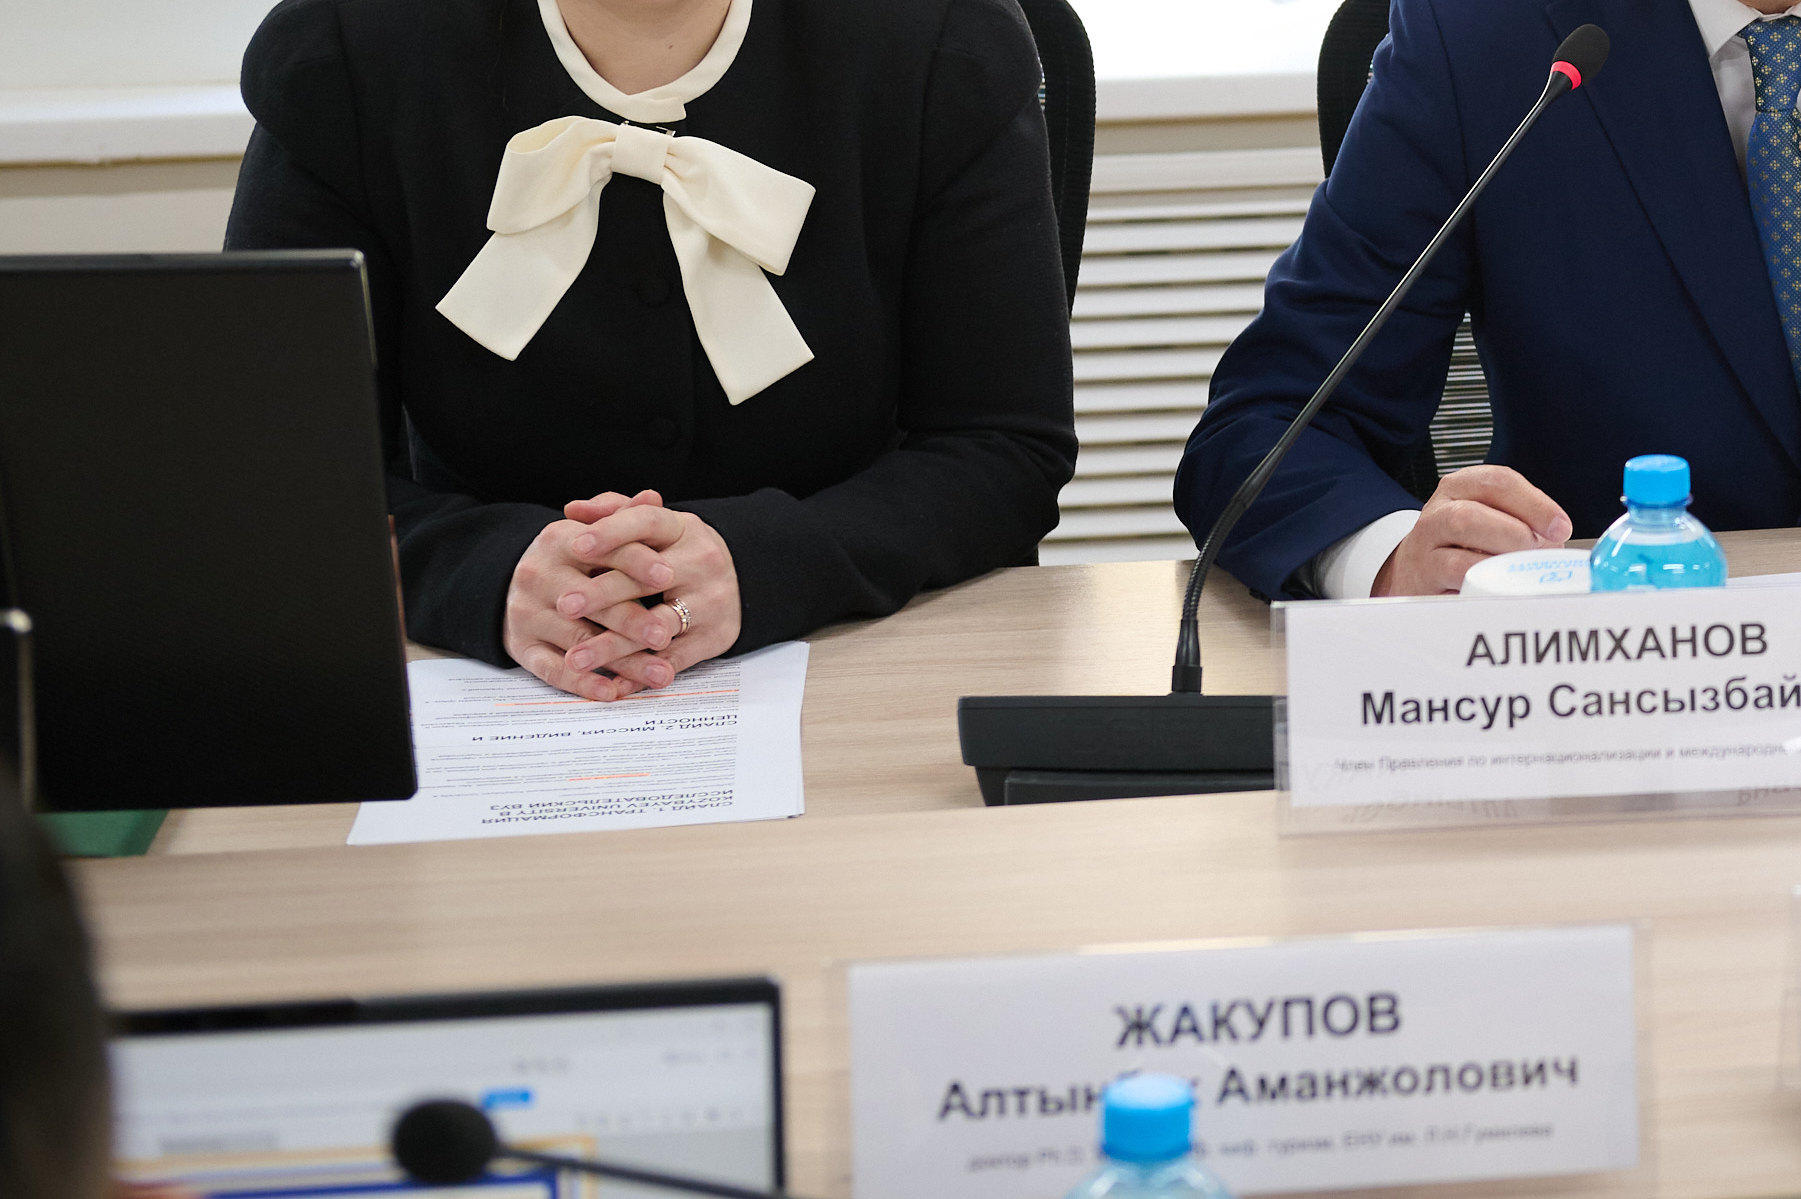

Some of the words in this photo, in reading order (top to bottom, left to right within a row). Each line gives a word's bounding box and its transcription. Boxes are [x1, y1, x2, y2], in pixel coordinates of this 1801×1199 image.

[1465, 622, 1770, 668] АЛИМХАНОВ
[1361, 690, 1532, 731] Мансур
[645, 715, 738, 725] ЦЕННОСТИ
[678, 720, 737, 729] СЛАЙД
[489, 732, 572, 741] ВИДЕНИЕ
[627, 796, 733, 808] KOZYBAYEV
[672, 801, 733, 811] СЛАЙД
[516, 804, 622, 816] UNIVERSITY
[481, 808, 647, 825] ТРАНСФОРМАЦИЯ
[1114, 990, 1403, 1049] ЖАКУПОВ
[1215, 1052, 1580, 1107] Аманжолович
